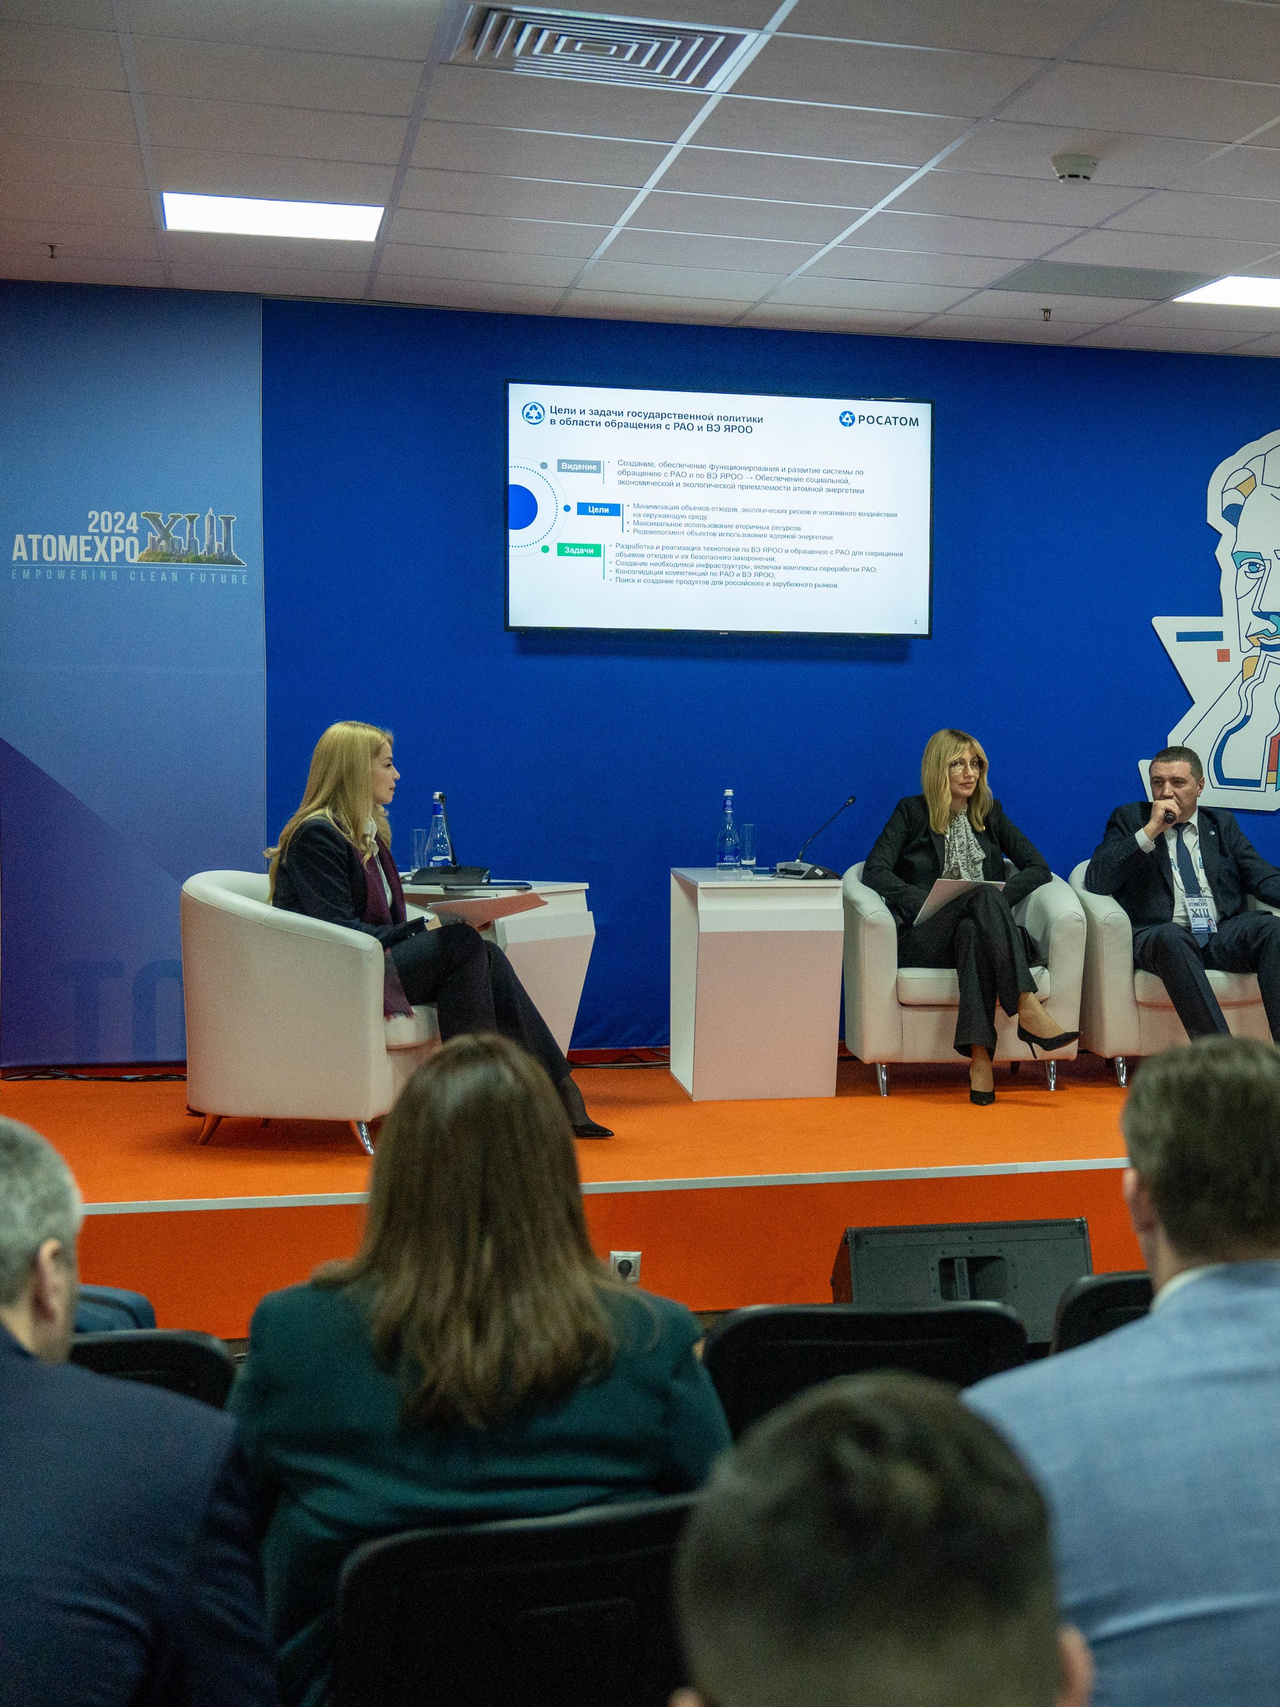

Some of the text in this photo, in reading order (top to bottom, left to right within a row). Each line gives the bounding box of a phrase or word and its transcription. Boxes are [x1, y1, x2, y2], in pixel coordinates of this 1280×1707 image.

[550, 405, 577, 417] Цели
[589, 409, 625, 419] задачи
[627, 408, 714, 423] государственной
[716, 415, 764, 423] политики
[858, 414, 919, 427] РОСАТОМ
[559, 416, 602, 427] области
[605, 418, 663, 431] обращения
[673, 422, 695, 431] РАО
[706, 423, 721, 432] ВЭ
[723, 424, 753, 433] ЯРОО
[561, 462, 597, 472] Видение
[659, 460, 707, 469] обеспечение
[709, 462, 780, 473] функционирования
[788, 467, 821, 475] развитие
[617, 468, 663, 478] обращению
[719, 472, 743, 480] ЯРОО
[755, 474, 804, 482] Обеспечение
[617, 478, 675, 487] экономической
[683, 480, 737, 489] экологической
[738, 484, 792, 493] приемлемости
[793, 484, 824, 492] атомной
[825, 487, 865, 495] энергетики
[588, 505, 609, 515] Цели
[88, 510, 139, 533] 2024
[12, 534, 139, 563] ATOMEXPO
[564, 546, 594, 556] Задачи
[11, 569, 248, 585] EMPOWERING CLEAN FUTURE
